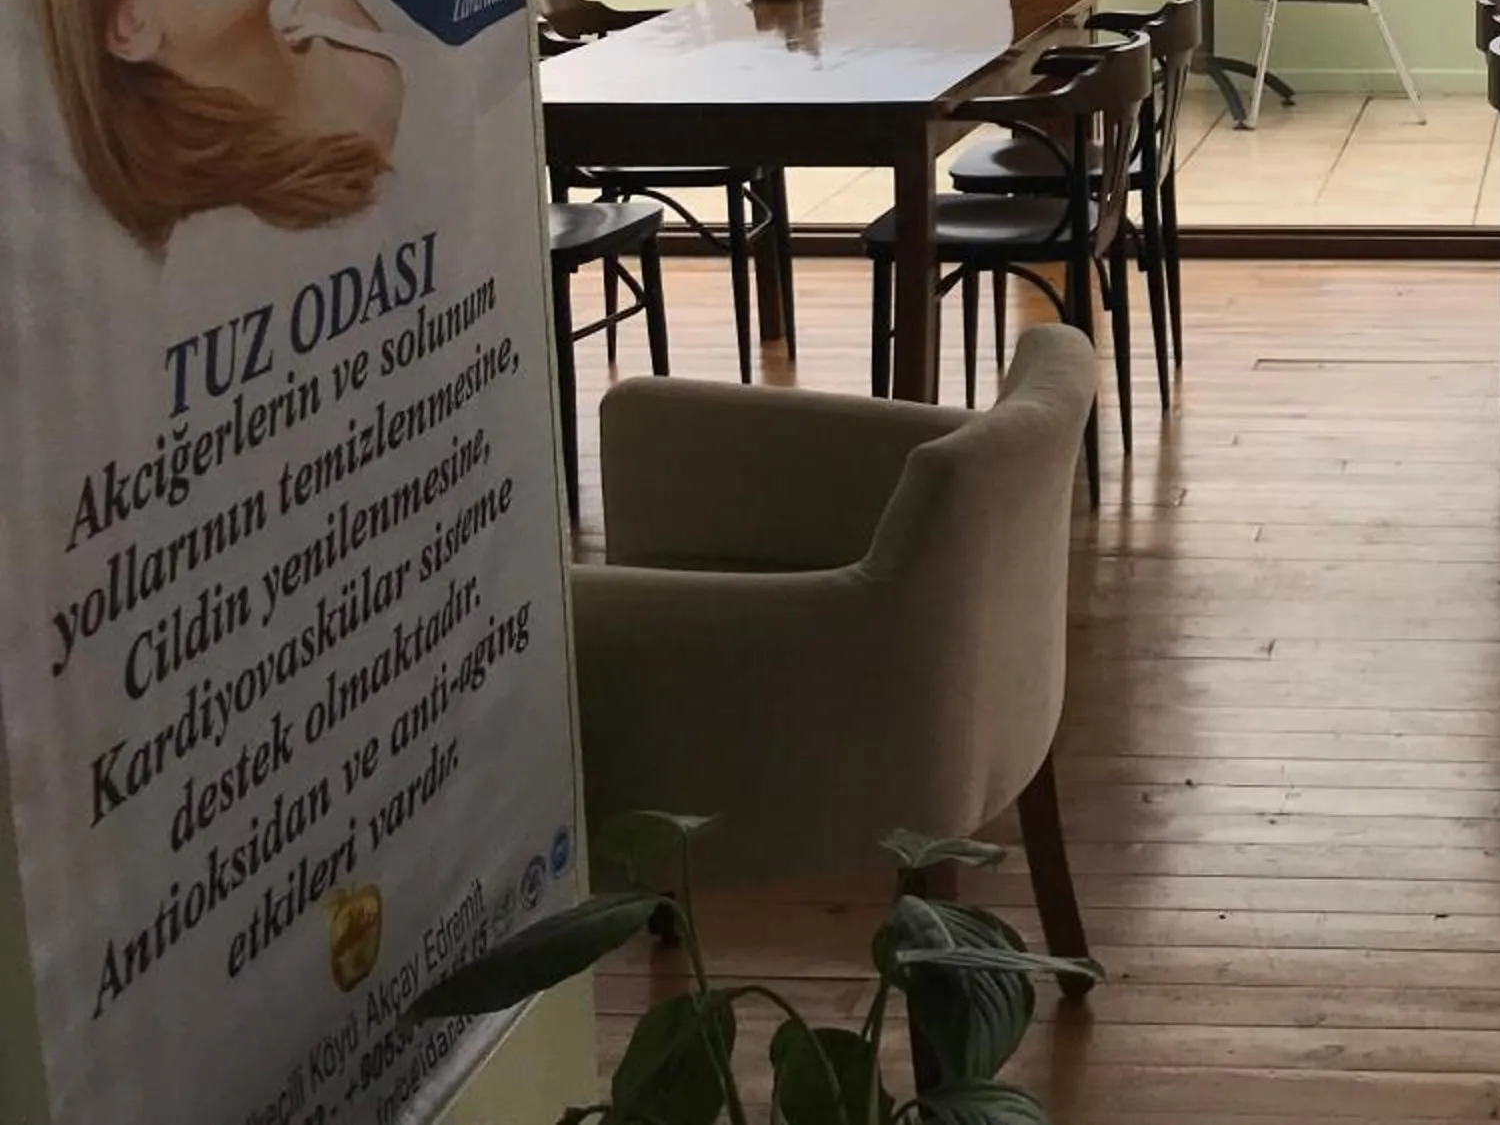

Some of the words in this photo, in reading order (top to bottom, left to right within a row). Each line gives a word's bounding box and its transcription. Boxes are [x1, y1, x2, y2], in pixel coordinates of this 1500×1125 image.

[65, 369, 321, 552] Akciğerlerin
[333, 352, 368, 391] ve
[381, 277, 496, 377] solunum
[165, 305, 274, 418] TUZ
[290, 232, 437, 355] ODASI
[52, 490, 267, 677] yollarının
[279, 335, 520, 515] temizlenmesine,
[124, 585, 251, 701] Cildin
[261, 428, 491, 626] yenilenmesine,
[89, 555, 412, 828] Kardiyovaskülar
[419, 476, 513, 582] sisteme
[170, 713, 294, 853] destek
[305, 574, 482, 745] olmaktadır.
[91, 778, 331, 1021] Antioksidan
[342, 736, 379, 795] ve
[390, 600, 532, 754] anti-aging
[227, 819, 357, 977] etkileri
[369, 737, 459, 851] vardır.
